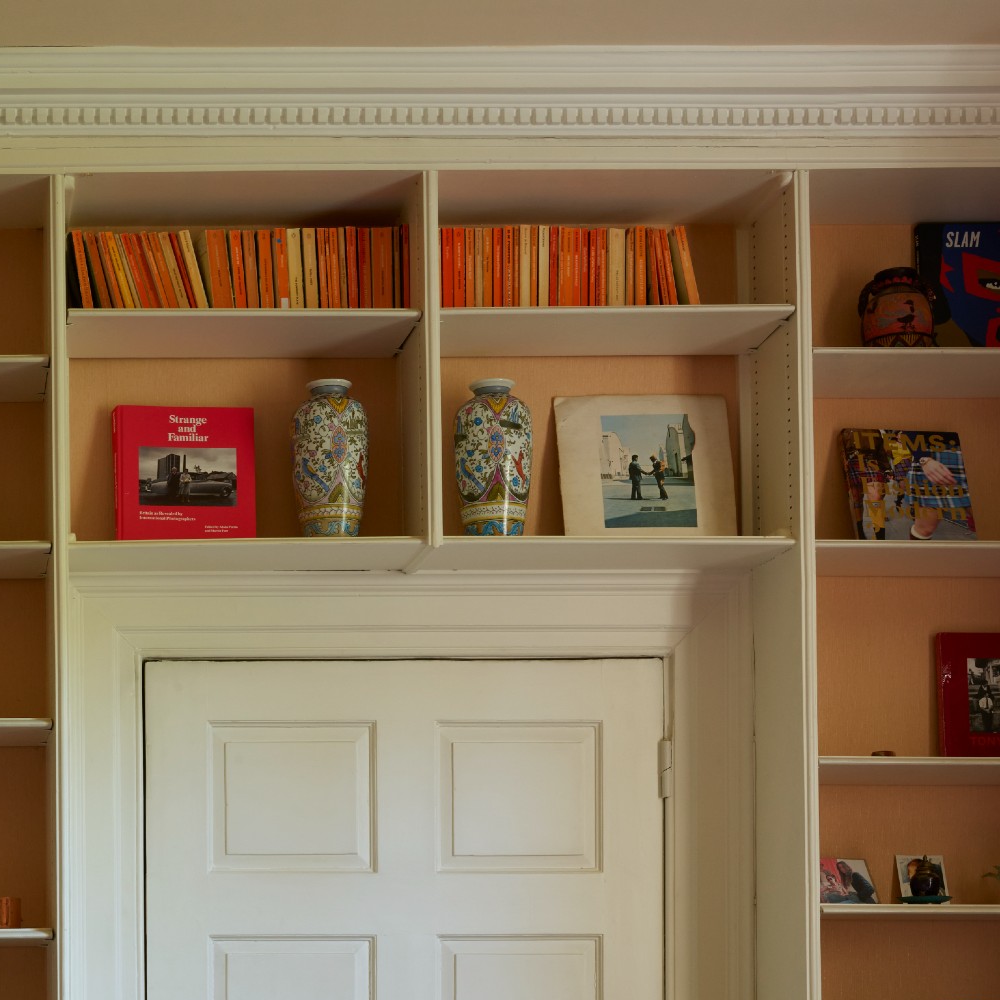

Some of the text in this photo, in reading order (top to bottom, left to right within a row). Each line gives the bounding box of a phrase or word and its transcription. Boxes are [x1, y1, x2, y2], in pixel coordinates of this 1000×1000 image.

[946, 231, 981, 248] SLAM
[168, 414, 208, 426] Strange
[168, 433, 208, 442] Familiar
[178, 425, 196, 433] and
[853, 431, 956, 452] ITEMS:
[857, 453, 880, 472] Is
[860, 476, 964, 497] Fashion
